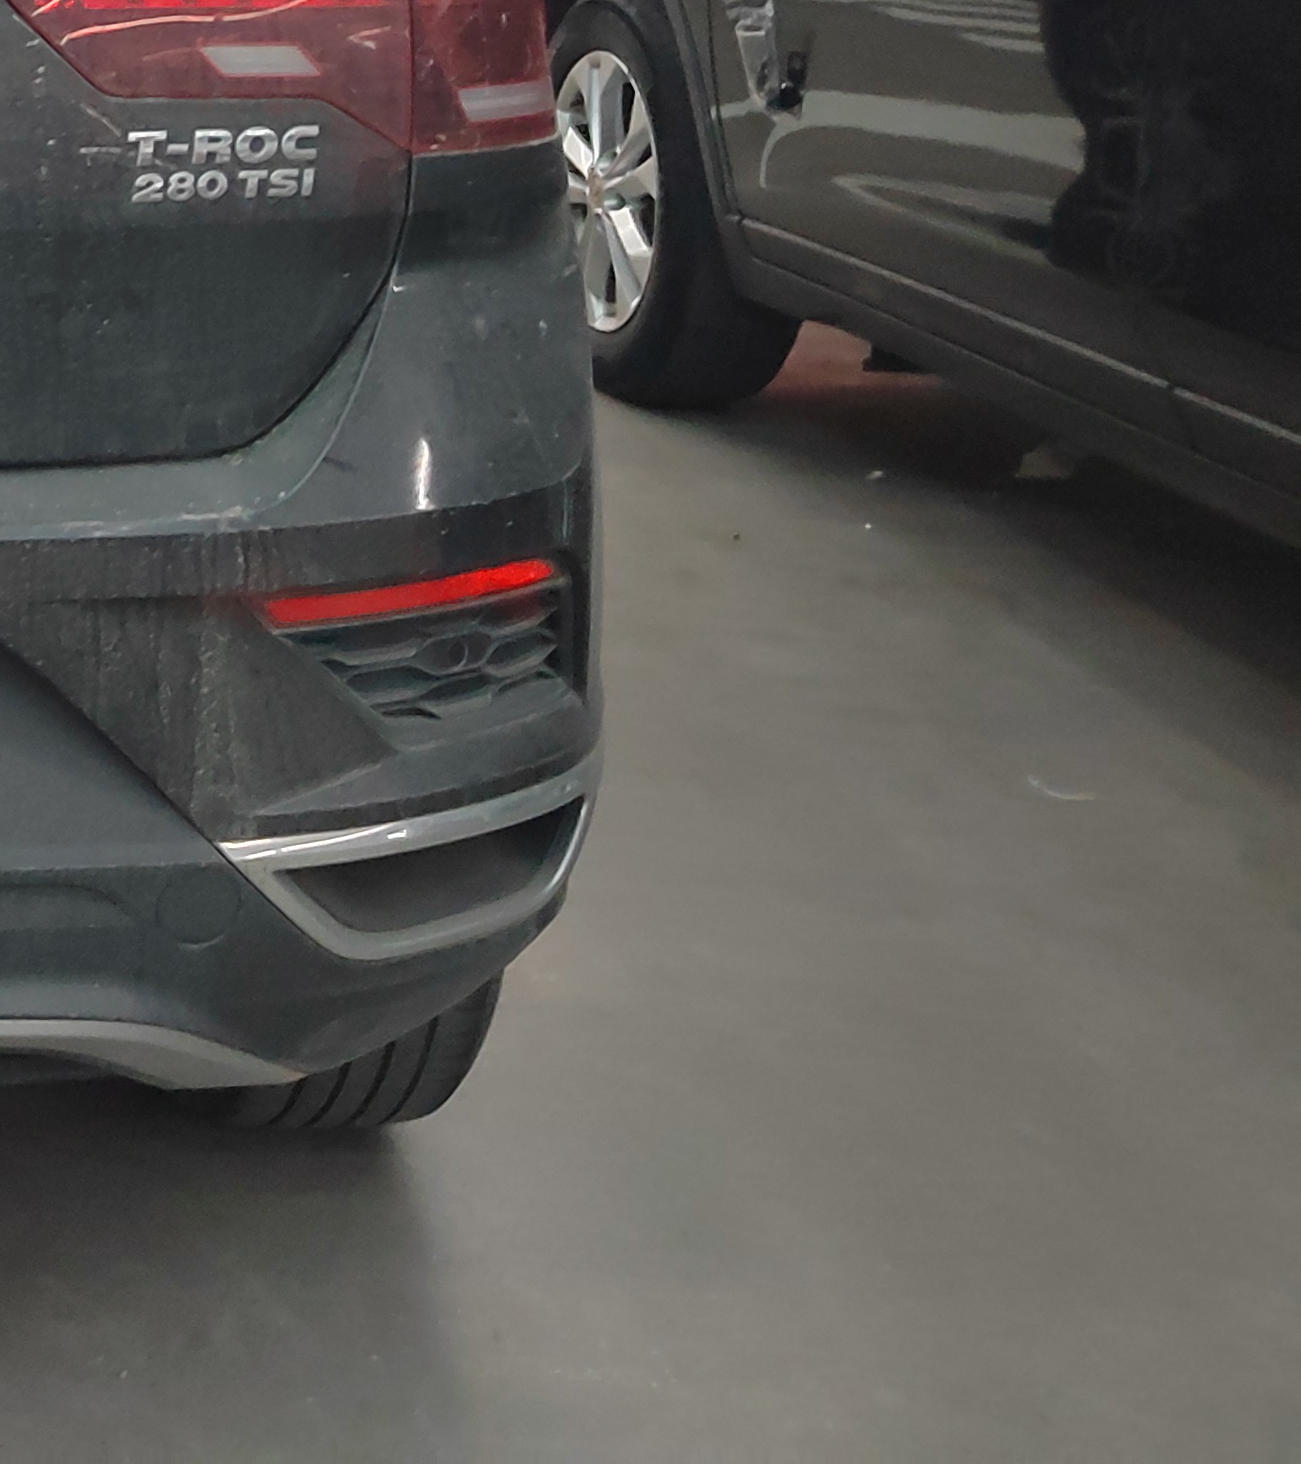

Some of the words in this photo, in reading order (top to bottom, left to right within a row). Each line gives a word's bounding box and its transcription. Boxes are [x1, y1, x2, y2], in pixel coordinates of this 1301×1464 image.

[127, 124, 320, 166] T-ROC
[131, 169, 228, 203] 280
[238, 167, 316, 198] TSI
